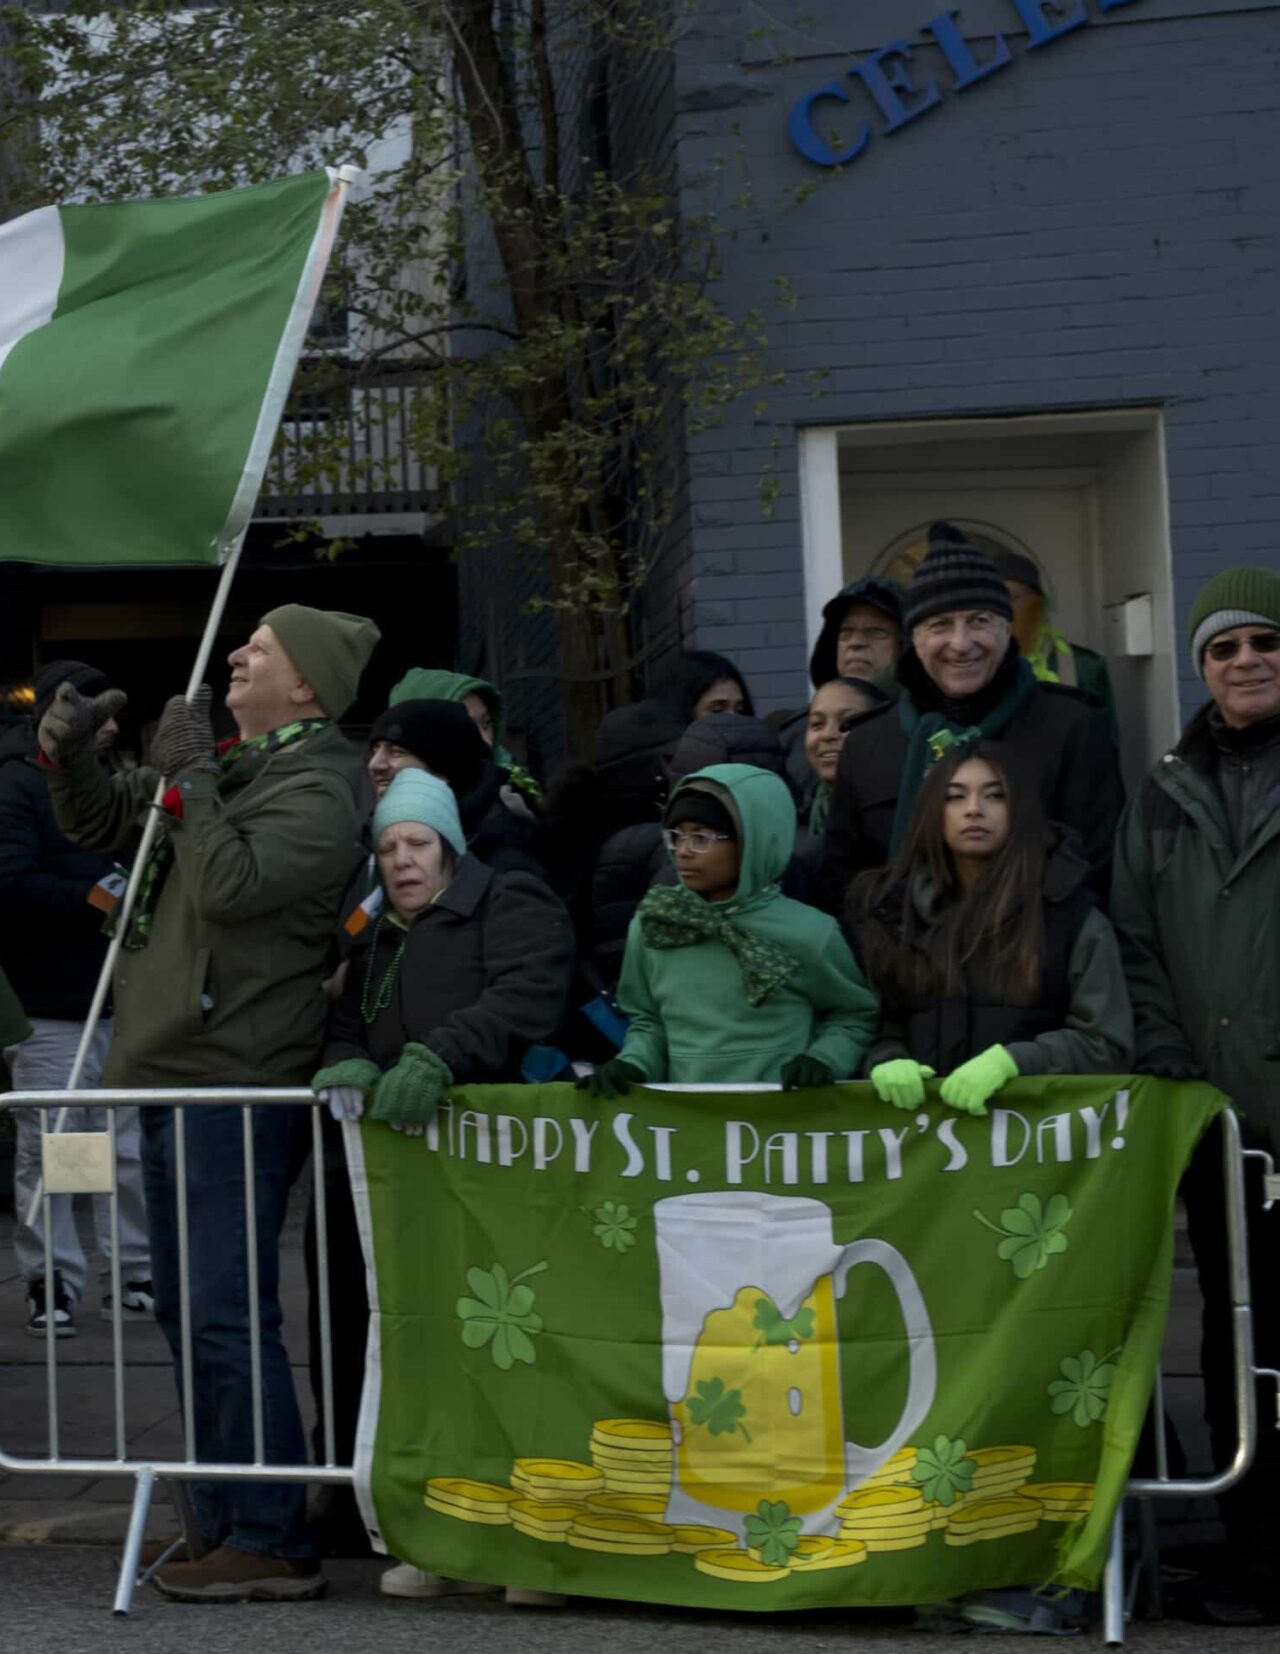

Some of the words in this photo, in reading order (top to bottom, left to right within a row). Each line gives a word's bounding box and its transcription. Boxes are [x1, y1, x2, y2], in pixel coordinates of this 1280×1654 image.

[789, 0, 1144, 166] CELE
[612, 1112, 701, 1182] ST.
[725, 1112, 968, 1185] PATTY'S
[990, 1089, 1130, 1168] DAY!
